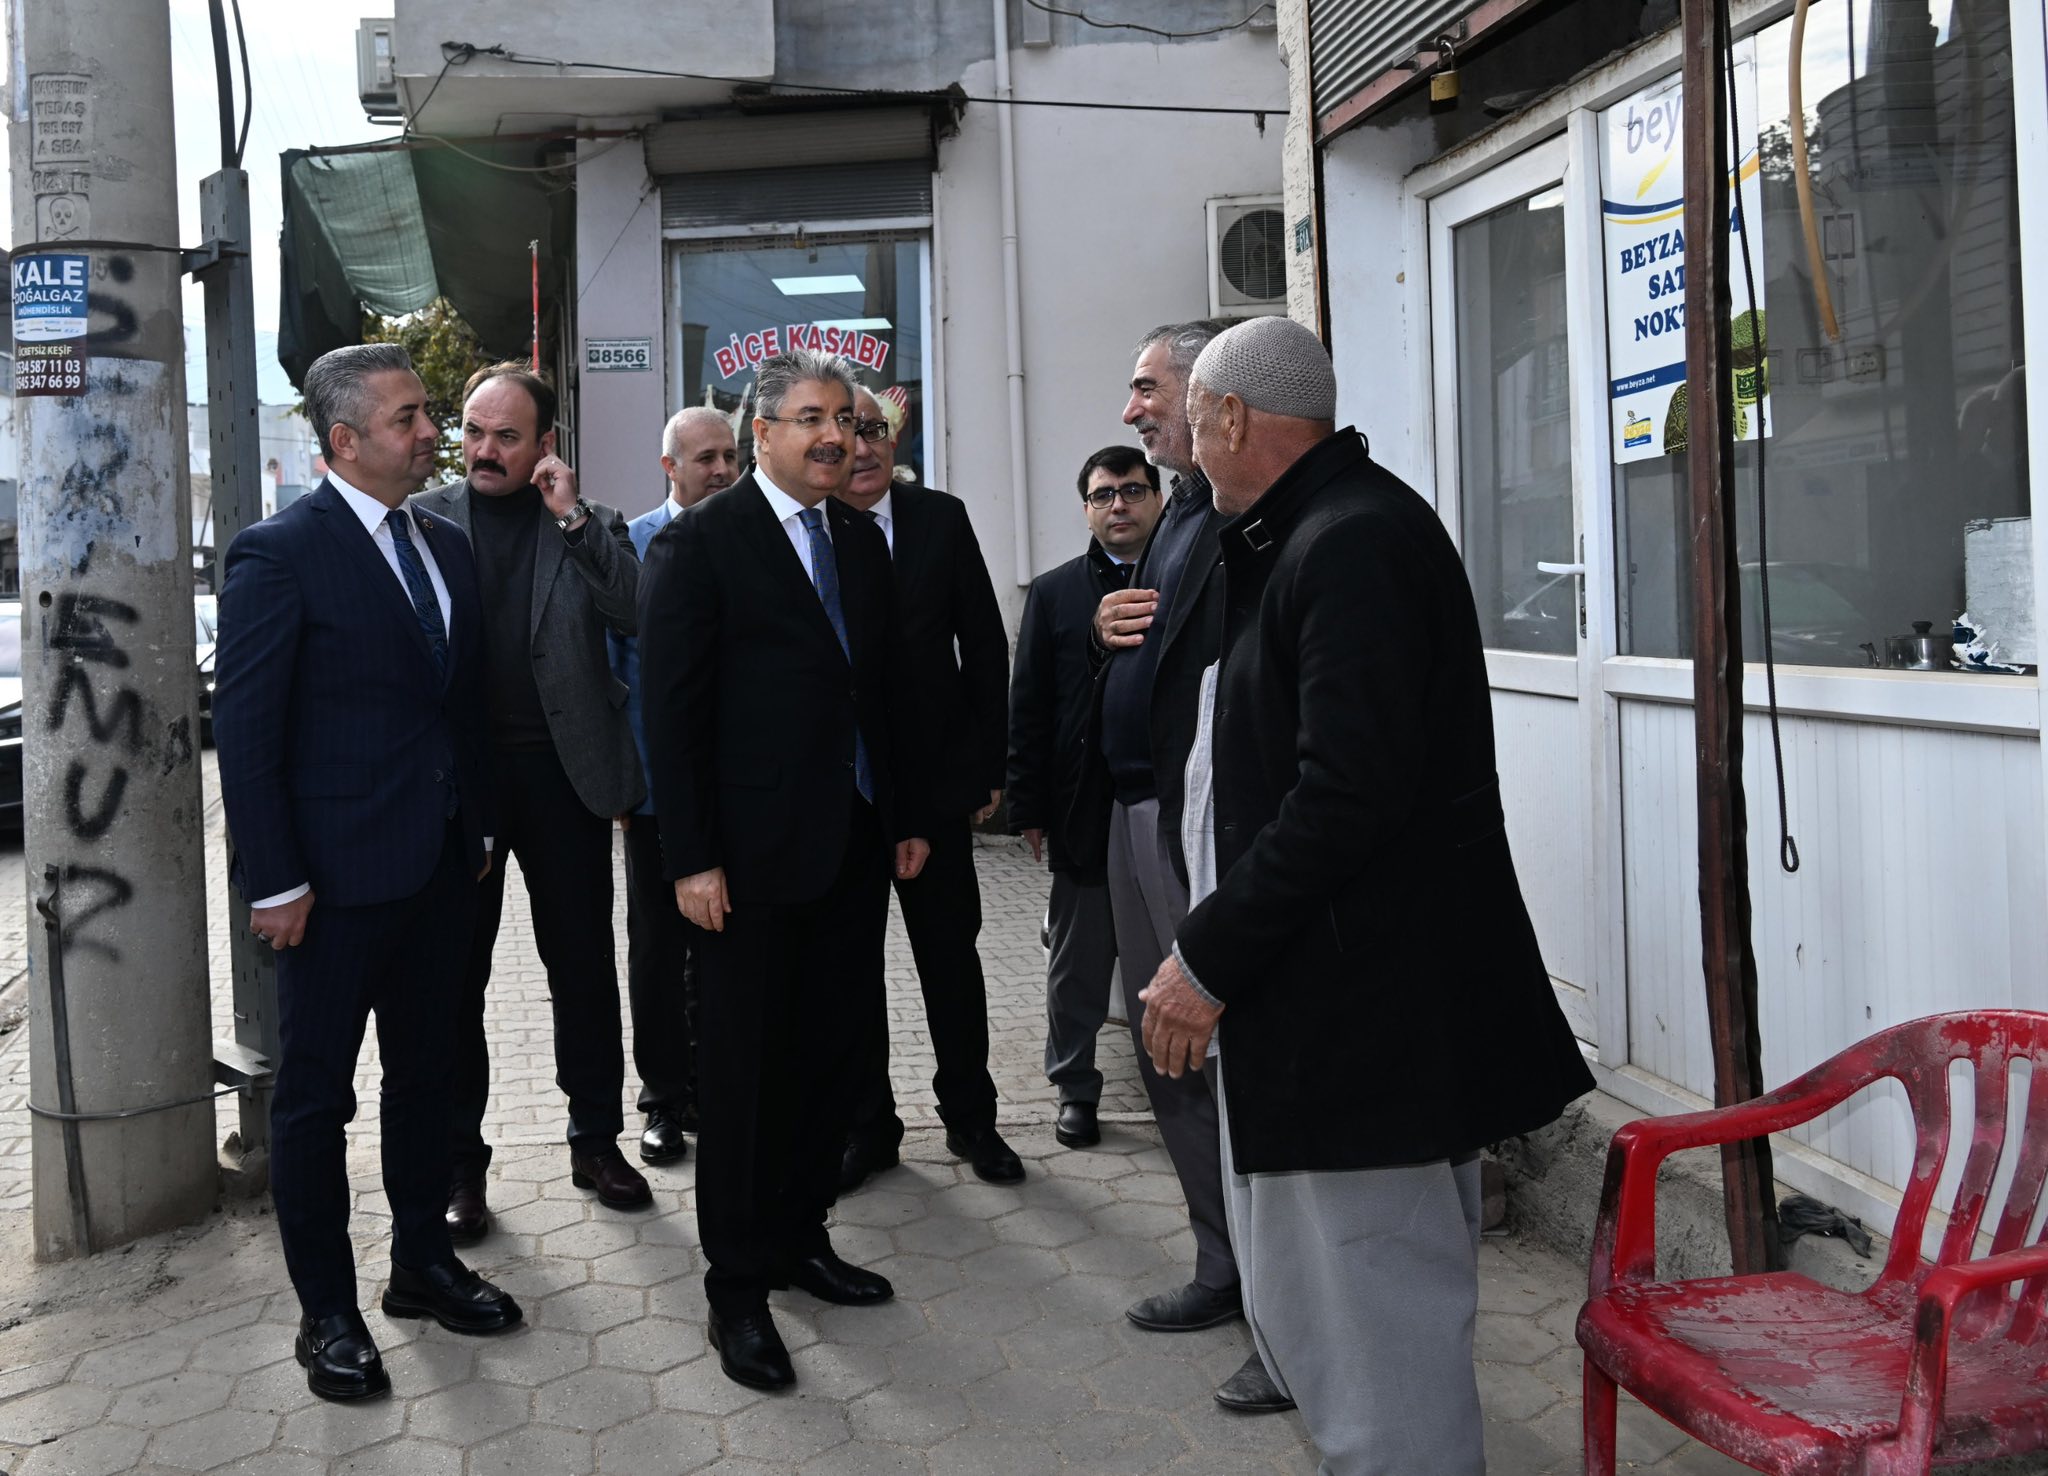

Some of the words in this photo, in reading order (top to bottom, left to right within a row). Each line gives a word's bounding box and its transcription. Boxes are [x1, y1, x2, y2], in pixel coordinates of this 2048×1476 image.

[35, 101, 86, 118] TEDAŞ
[1627, 94, 1682, 154] bey
[1620, 228, 1685, 275] BEYZA
[15, 260, 84, 288] KALE
[15, 287, 84, 304] DOĞALGAZ
[47, 344, 73, 357] KEŞİF
[601, 349, 646, 363] 8566
[714, 327, 782, 380] BİÇE
[786, 323, 890, 373] KASABI
[30, 359, 47, 373] 587
[49, 359, 62, 373] 11
[65, 359, 81, 373] 03
[30, 375, 47, 389] 347
[48, 375, 63, 389] 66
[64, 375, 81, 389] 99
[1616, 374, 1656, 391] www.beyza.net
